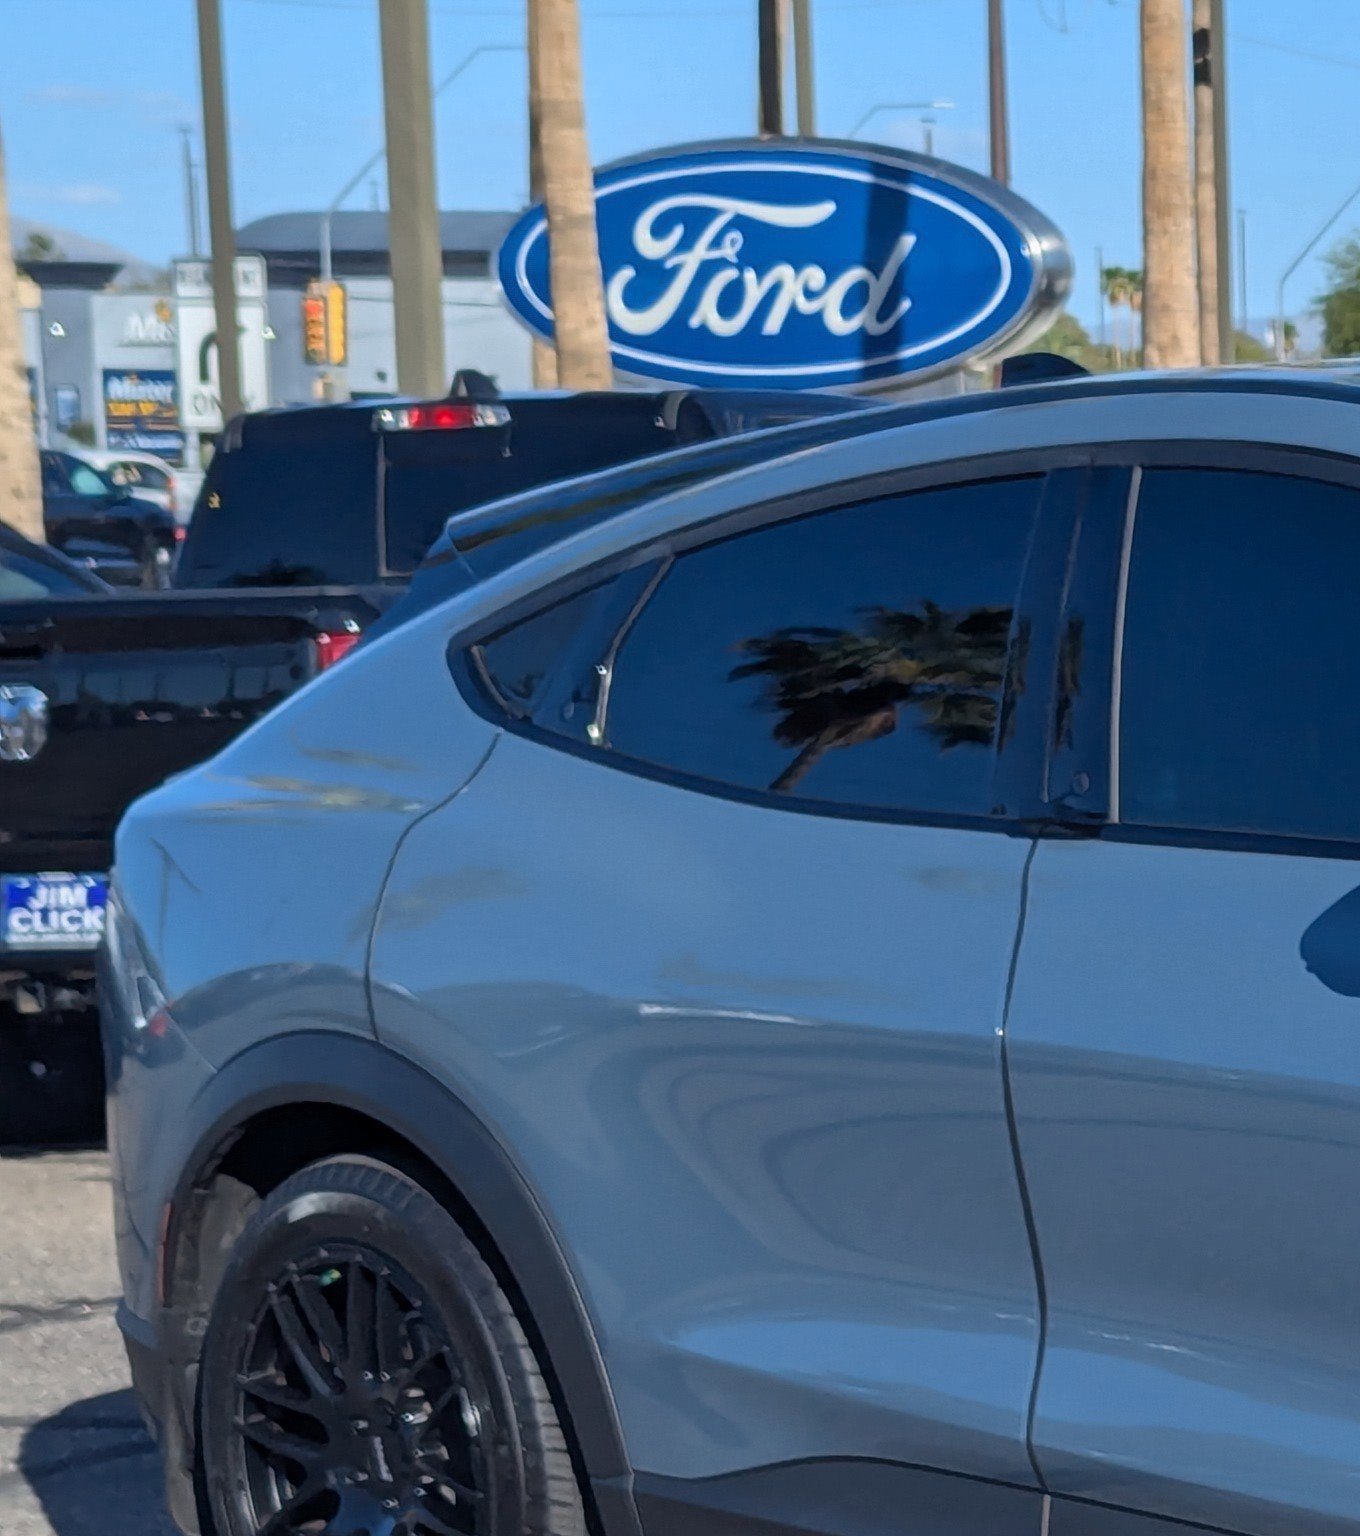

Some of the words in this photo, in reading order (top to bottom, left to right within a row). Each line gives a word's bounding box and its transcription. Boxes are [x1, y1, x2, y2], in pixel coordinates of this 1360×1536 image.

[606, 192, 912, 338] Ford
[25, 883, 88, 911] JIM
[8, 905, 105, 933] CLICK
